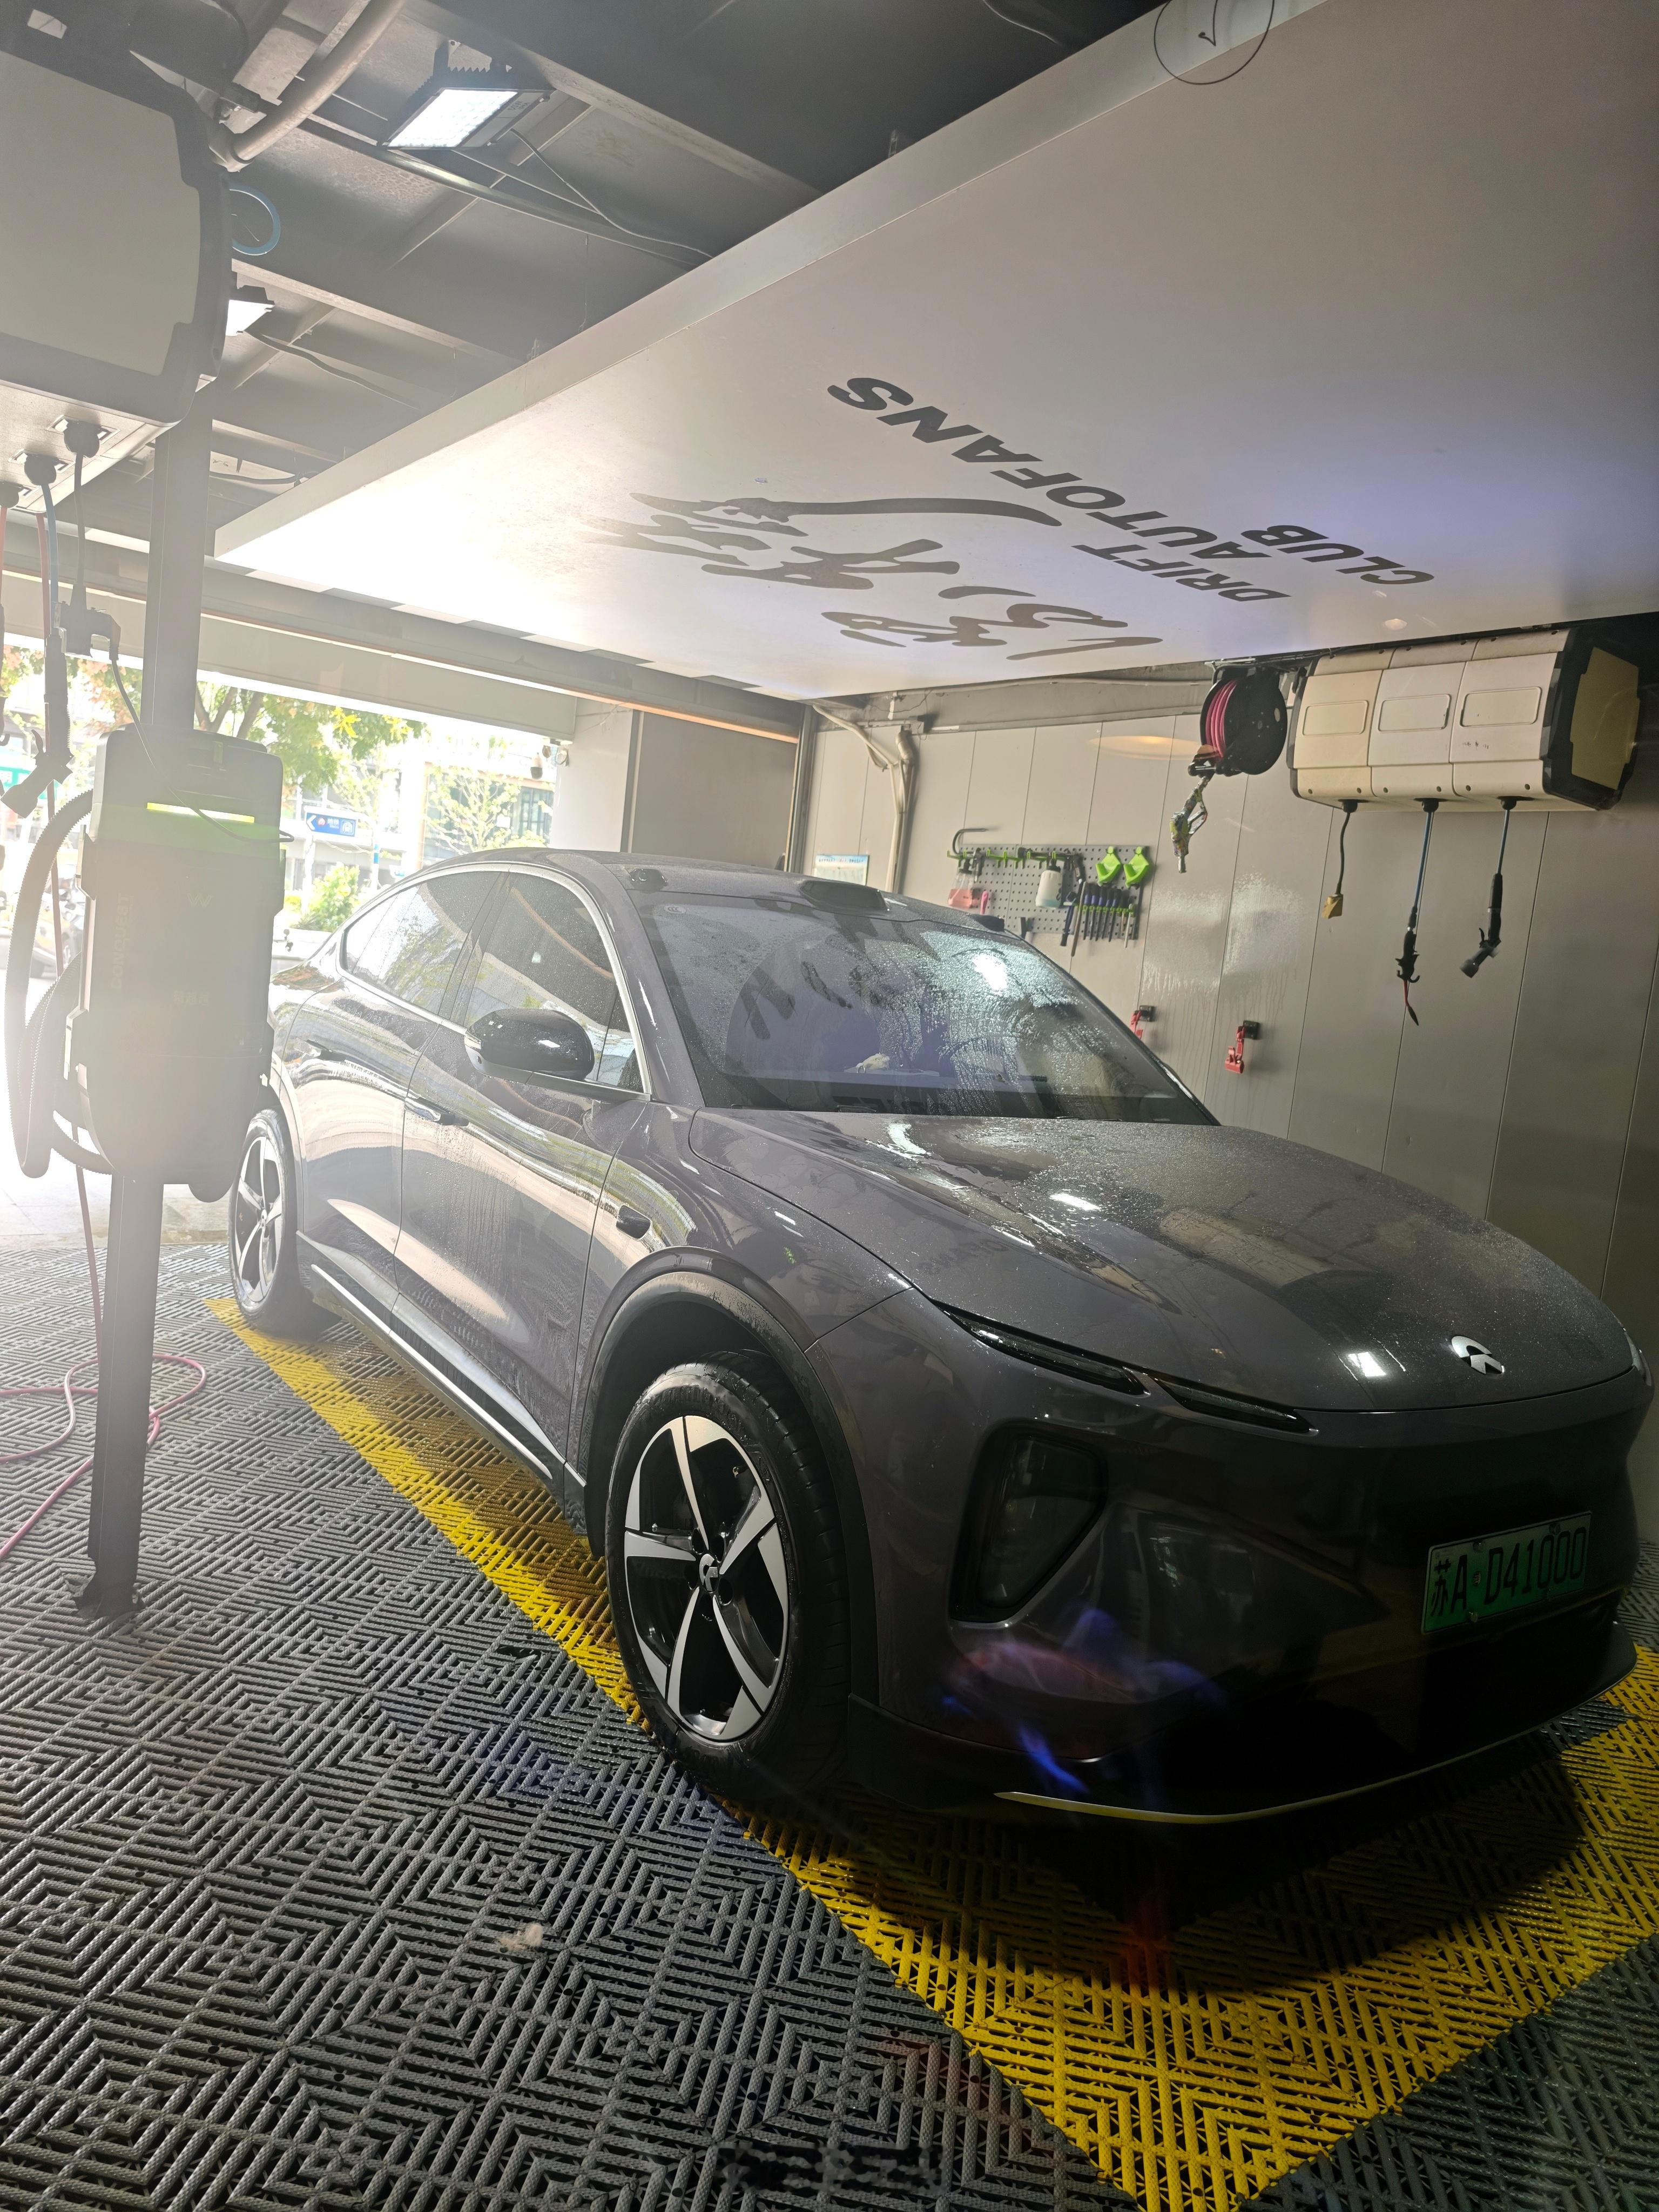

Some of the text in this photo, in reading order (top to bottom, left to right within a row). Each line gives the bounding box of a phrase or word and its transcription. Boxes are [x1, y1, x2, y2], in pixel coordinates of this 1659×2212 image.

[827, 377, 1273, 559] AUTOFANS
[1071, 544, 1292, 602] DRIFT
[1240, 525, 1435, 585] CLUB
